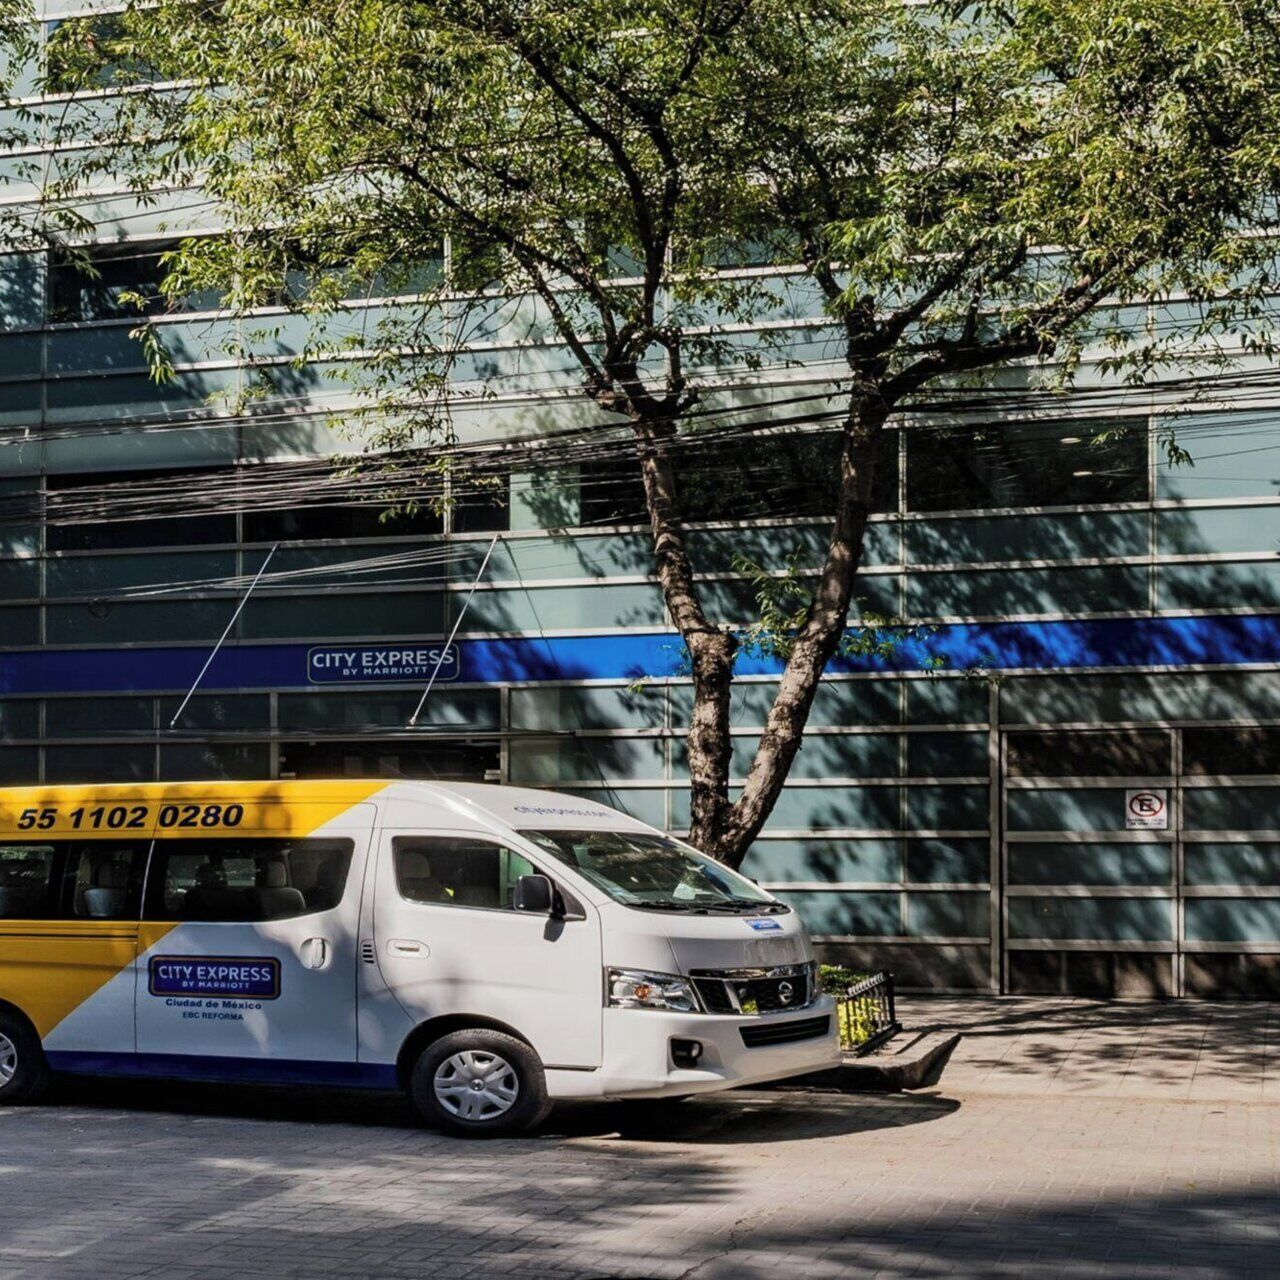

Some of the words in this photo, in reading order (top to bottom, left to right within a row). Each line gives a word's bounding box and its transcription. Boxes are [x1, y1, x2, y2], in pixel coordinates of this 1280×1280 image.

[312, 652, 356, 668] CITY
[362, 649, 455, 666] EXPRESS
[342, 668, 358, 676] BY
[363, 666, 428, 675] MARRIOTT
[17, 808, 59, 829] 55
[69, 806, 149, 829] 1102
[158, 804, 244, 828] 0280
[158, 965, 193, 979] CITY
[197, 966, 272, 981] EXPRESS
[198, 981, 250, 989] MARRIOTT
[165, 998, 203, 1008] Ciudad
[205, 999, 219, 1009] de
[222, 1000, 262, 1010] México
[202, 1011, 245, 1021] REFORMA
